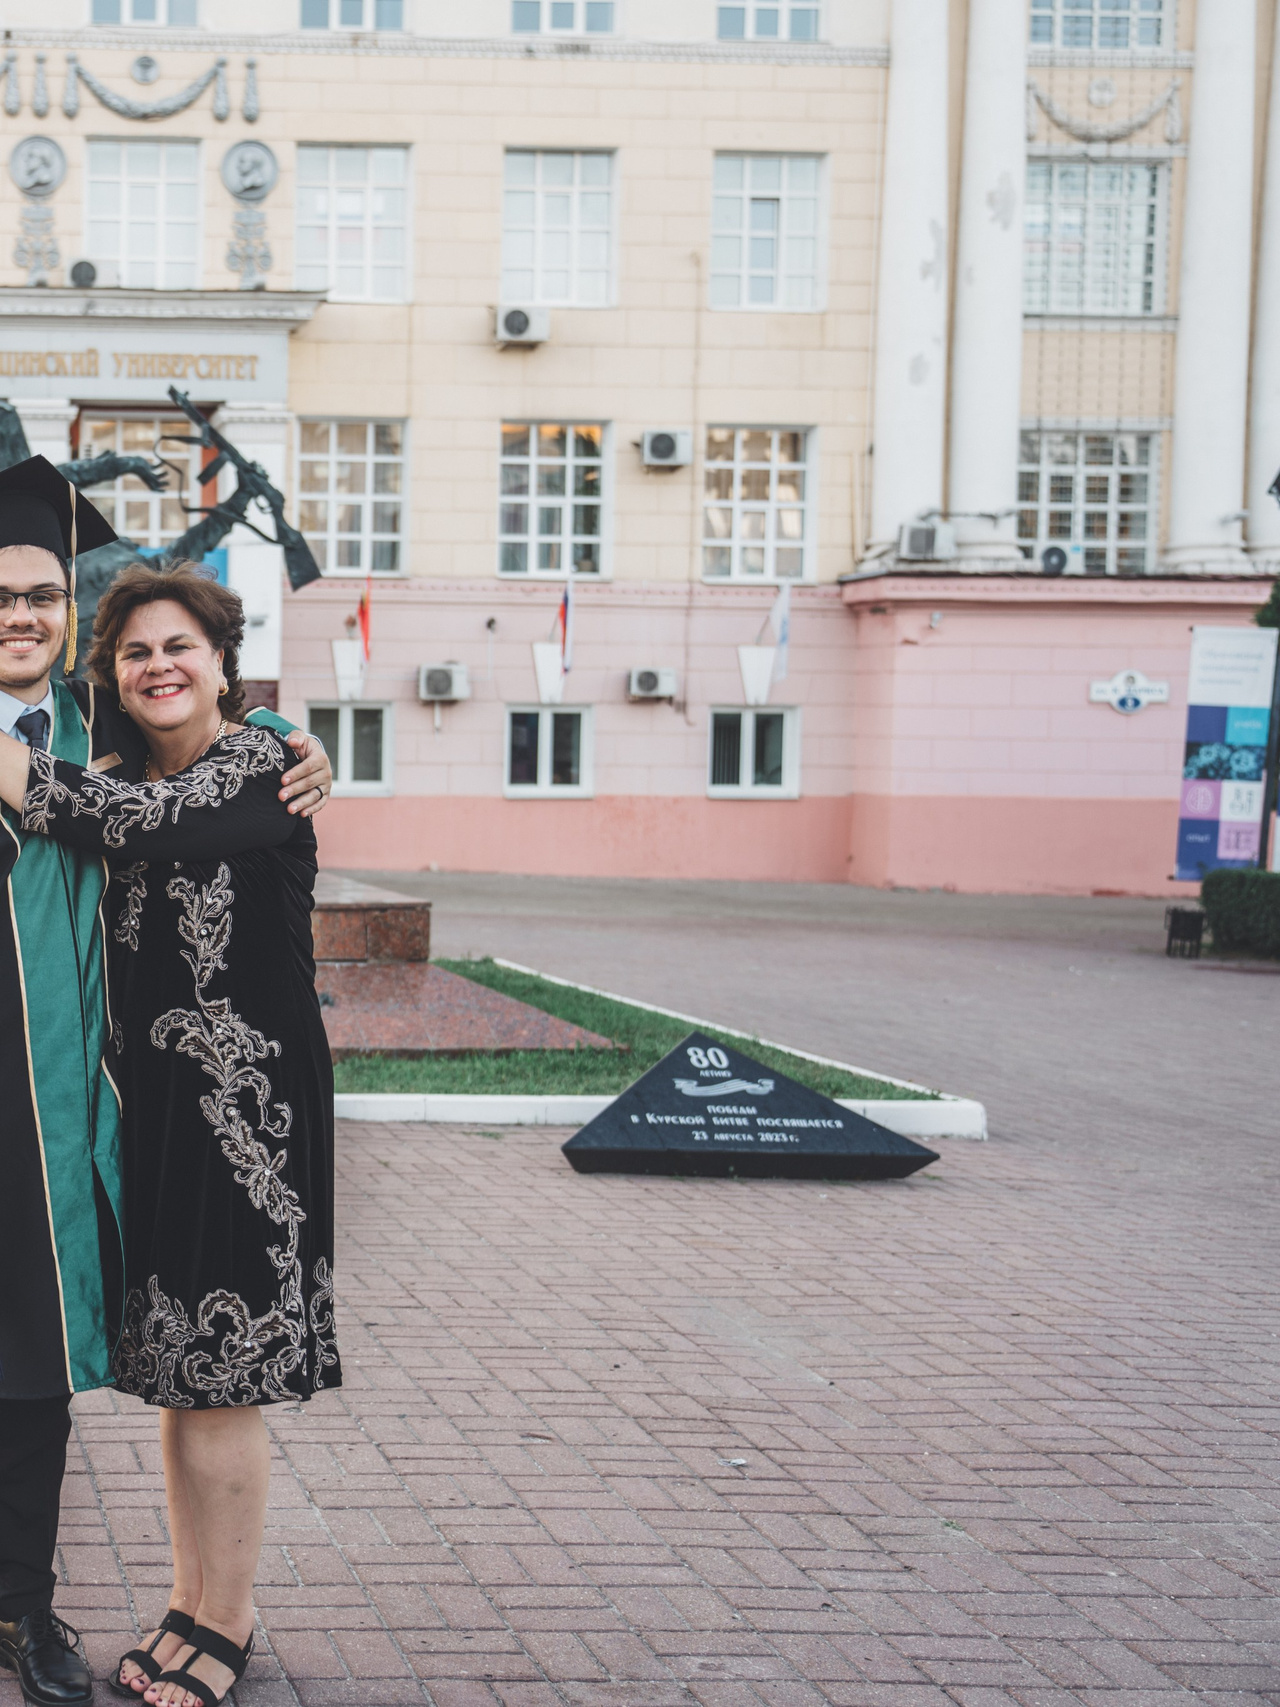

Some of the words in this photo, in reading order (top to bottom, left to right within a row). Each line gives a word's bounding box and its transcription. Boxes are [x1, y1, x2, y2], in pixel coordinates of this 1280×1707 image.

[112, 351, 259, 380] УНИВЕРСИТЕТ
[686, 1046, 729, 1069] 80
[712, 1116, 750, 1126] БИТВЕ
[691, 1130, 709, 1141] 23
[713, 1133, 754, 1141] АВГУСТА
[757, 1132, 789, 1142] 2023
